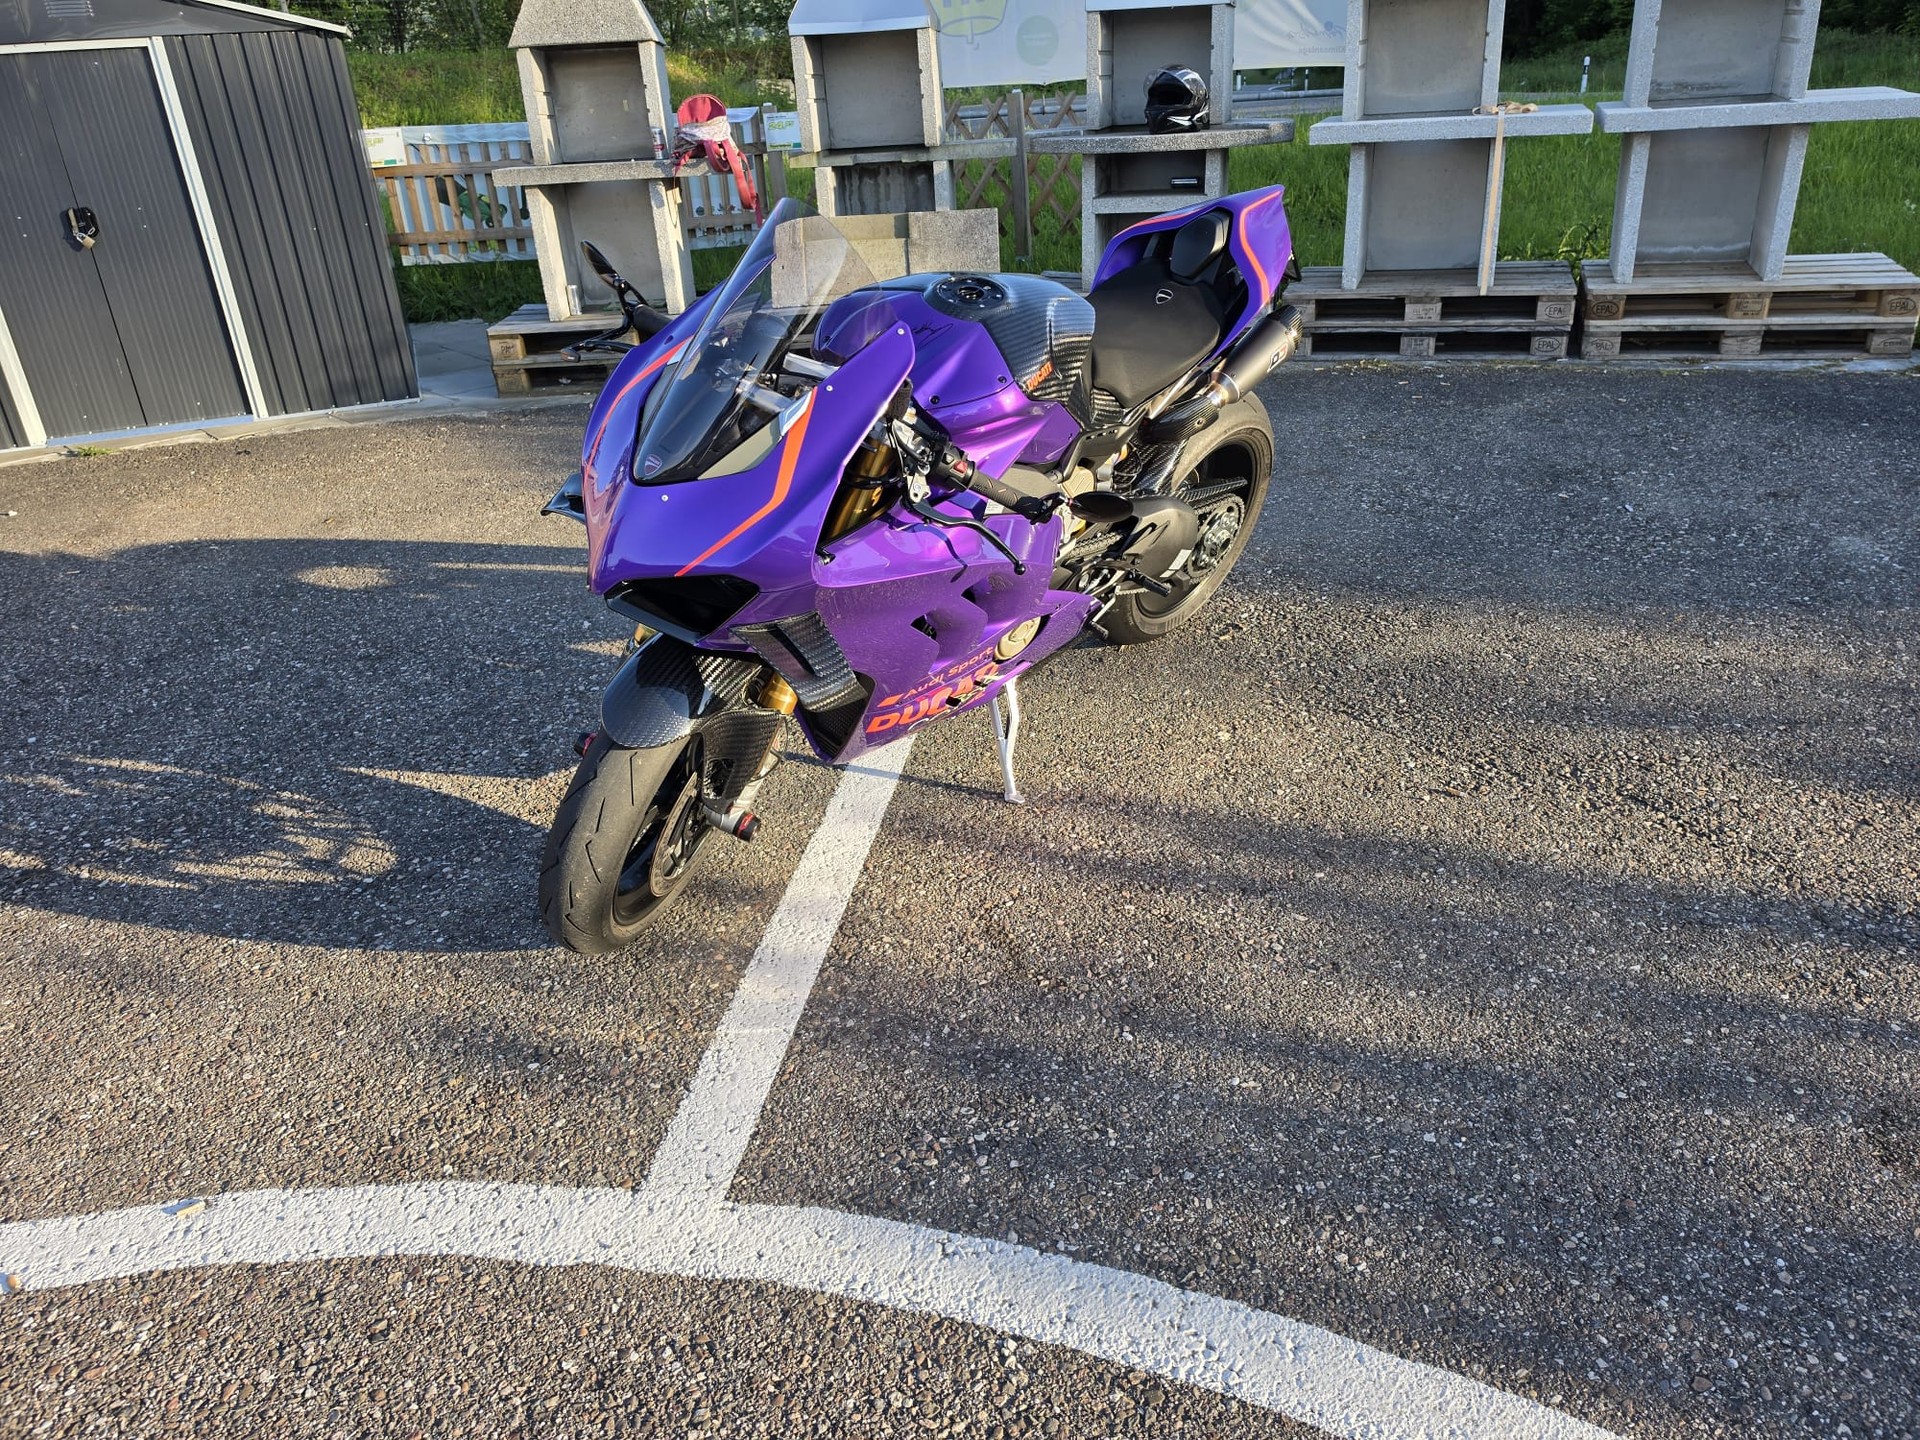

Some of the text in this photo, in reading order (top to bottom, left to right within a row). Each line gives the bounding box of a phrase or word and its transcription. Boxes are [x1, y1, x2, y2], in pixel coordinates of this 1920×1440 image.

[1026, 361, 1052, 390] DUCATI
[903, 646, 994, 699] Audi Sport
